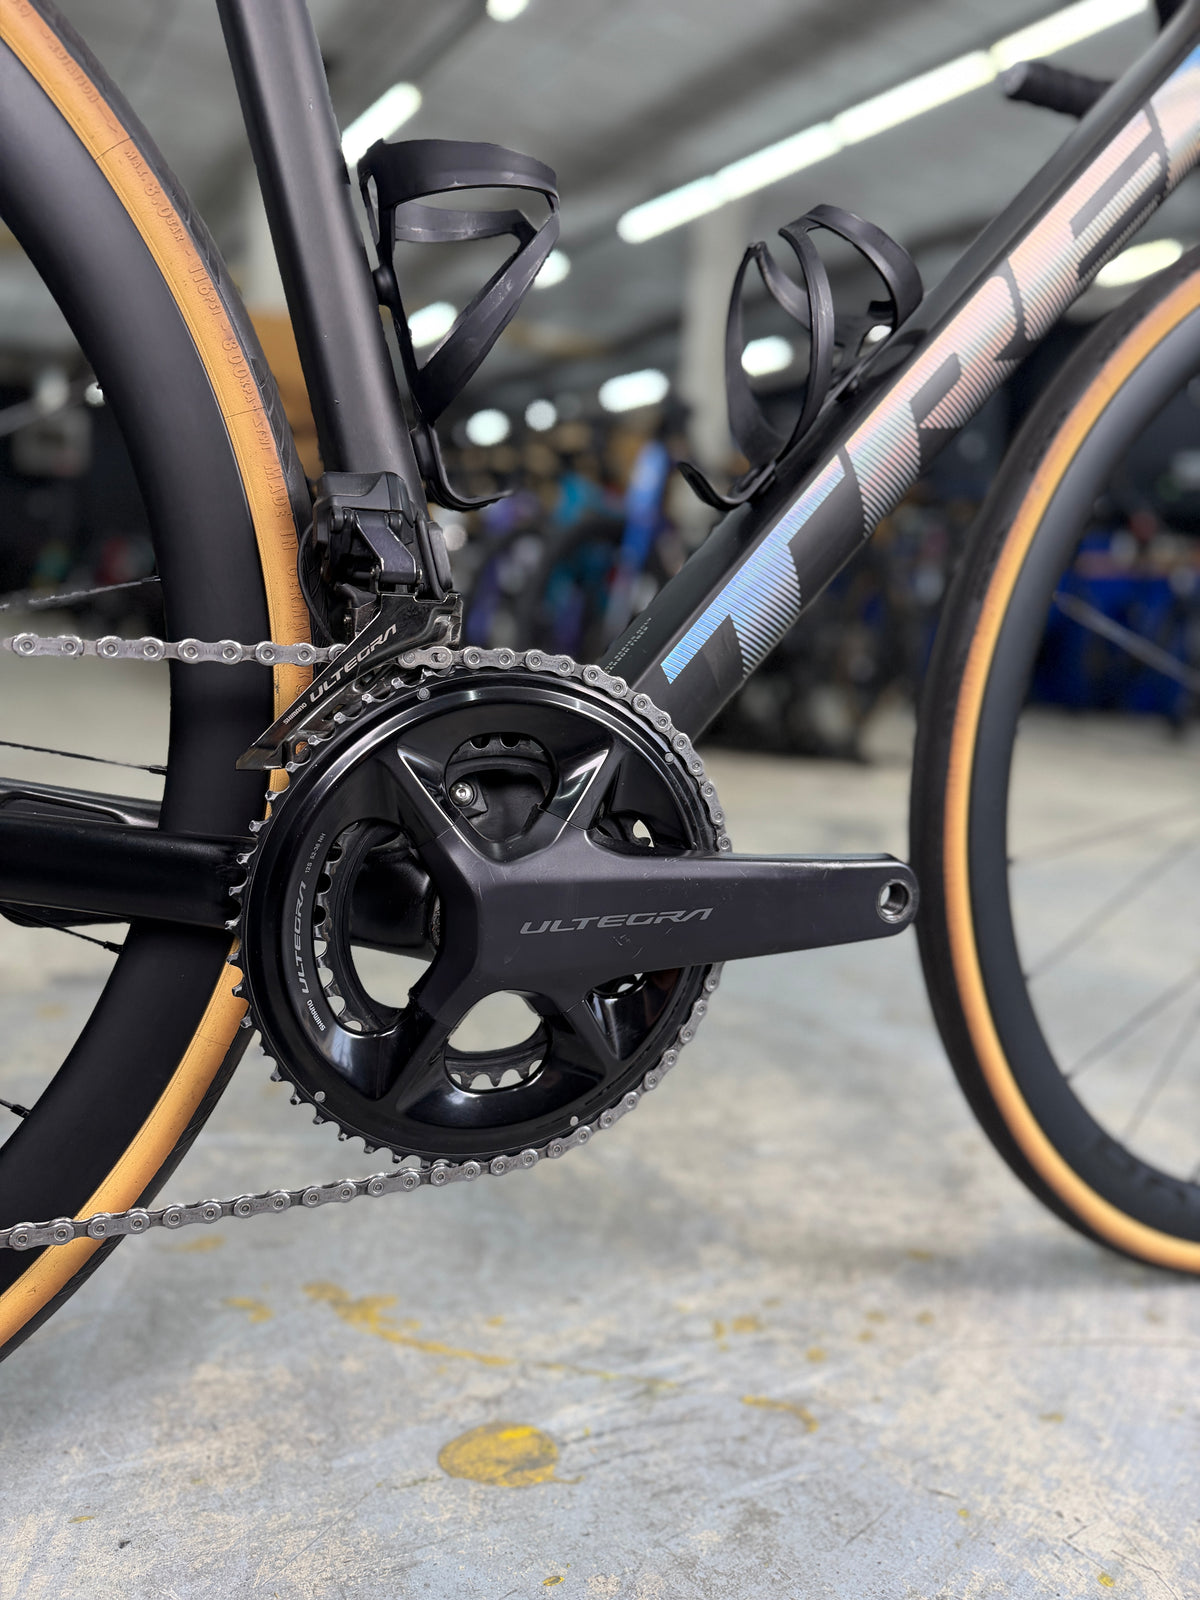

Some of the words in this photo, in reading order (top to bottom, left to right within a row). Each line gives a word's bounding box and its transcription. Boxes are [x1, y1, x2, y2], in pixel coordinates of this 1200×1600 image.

[280, 532, 297, 551] IN
[283, 702, 308, 725] SHIMANO
[309, 624, 398, 703] ULTEGRA
[294, 880, 310, 995] ULTEGRA
[519, 907, 714, 935] ULTEGRA
[306, 999, 326, 1032] SHIMANO
